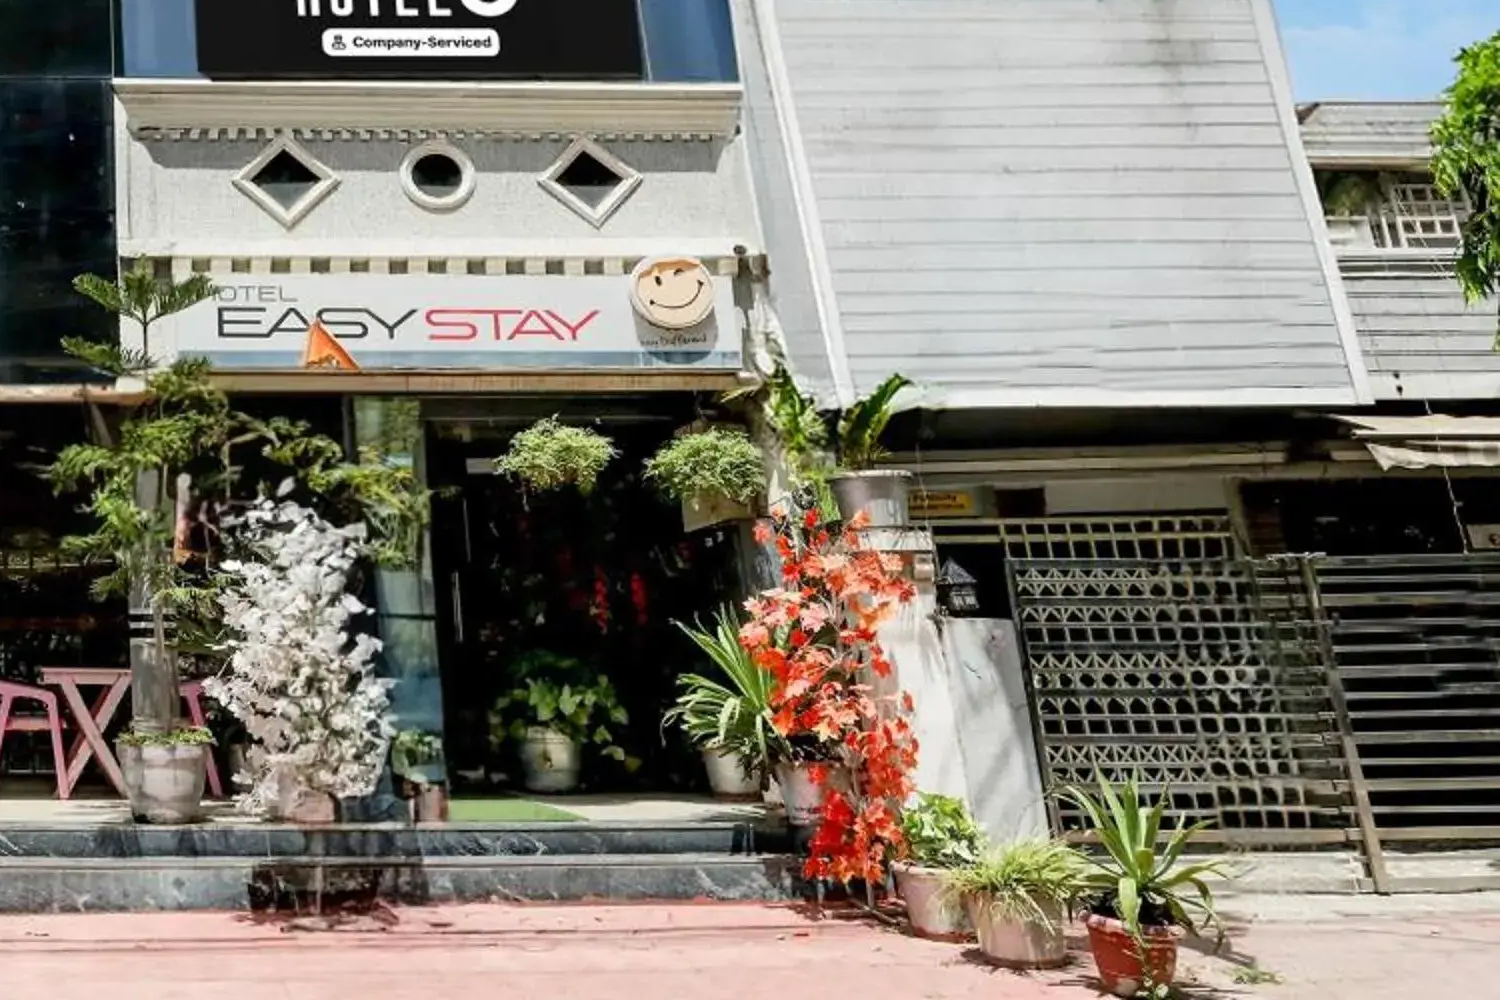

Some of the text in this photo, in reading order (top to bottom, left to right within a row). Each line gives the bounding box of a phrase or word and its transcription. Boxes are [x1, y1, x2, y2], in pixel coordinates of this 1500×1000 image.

[352, 34, 492, 51] Company-Serviced
[212, 285, 298, 302] OTEL
[218, 307, 600, 341] EASY STAY
